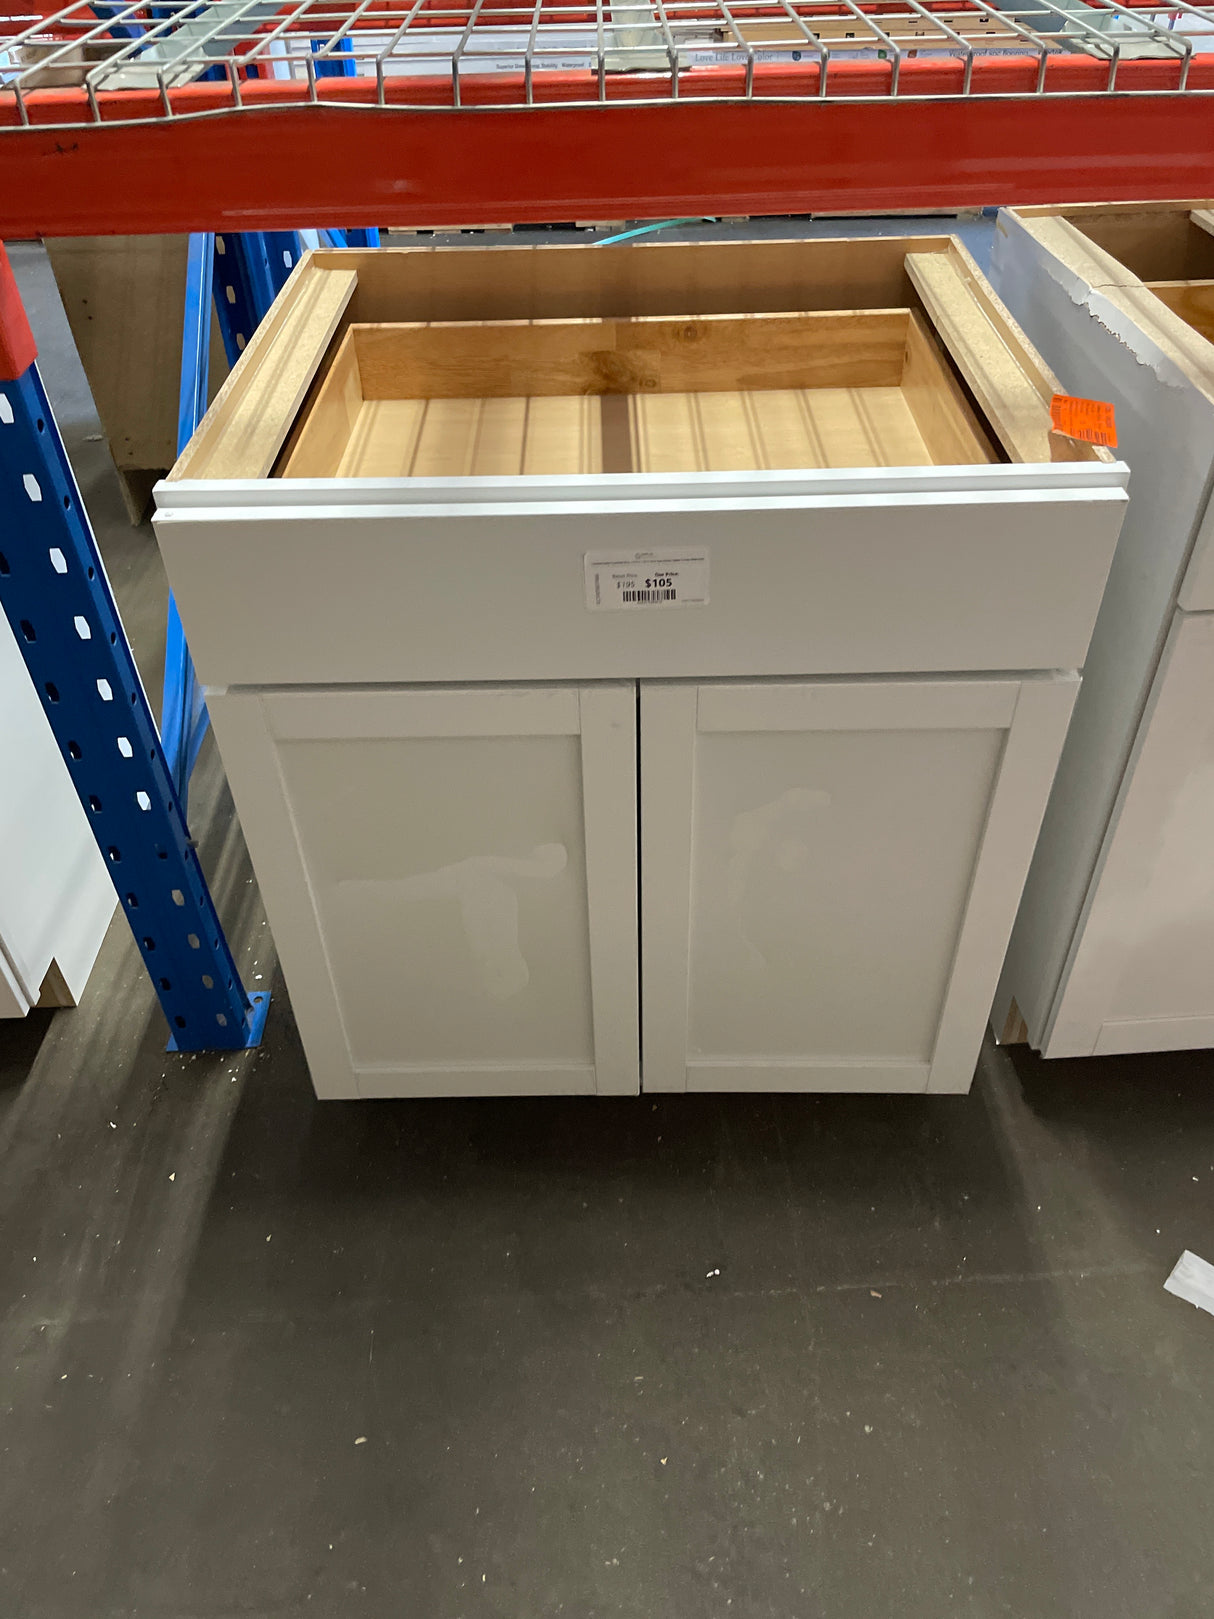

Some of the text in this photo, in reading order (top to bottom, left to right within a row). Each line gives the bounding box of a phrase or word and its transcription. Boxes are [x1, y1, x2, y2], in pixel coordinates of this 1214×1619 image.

[695, 53, 713, 62] Love
[715, 52, 728, 61] Life
[948, 48, 987, 57] Waterroof
[645, 578, 672, 588] $105
